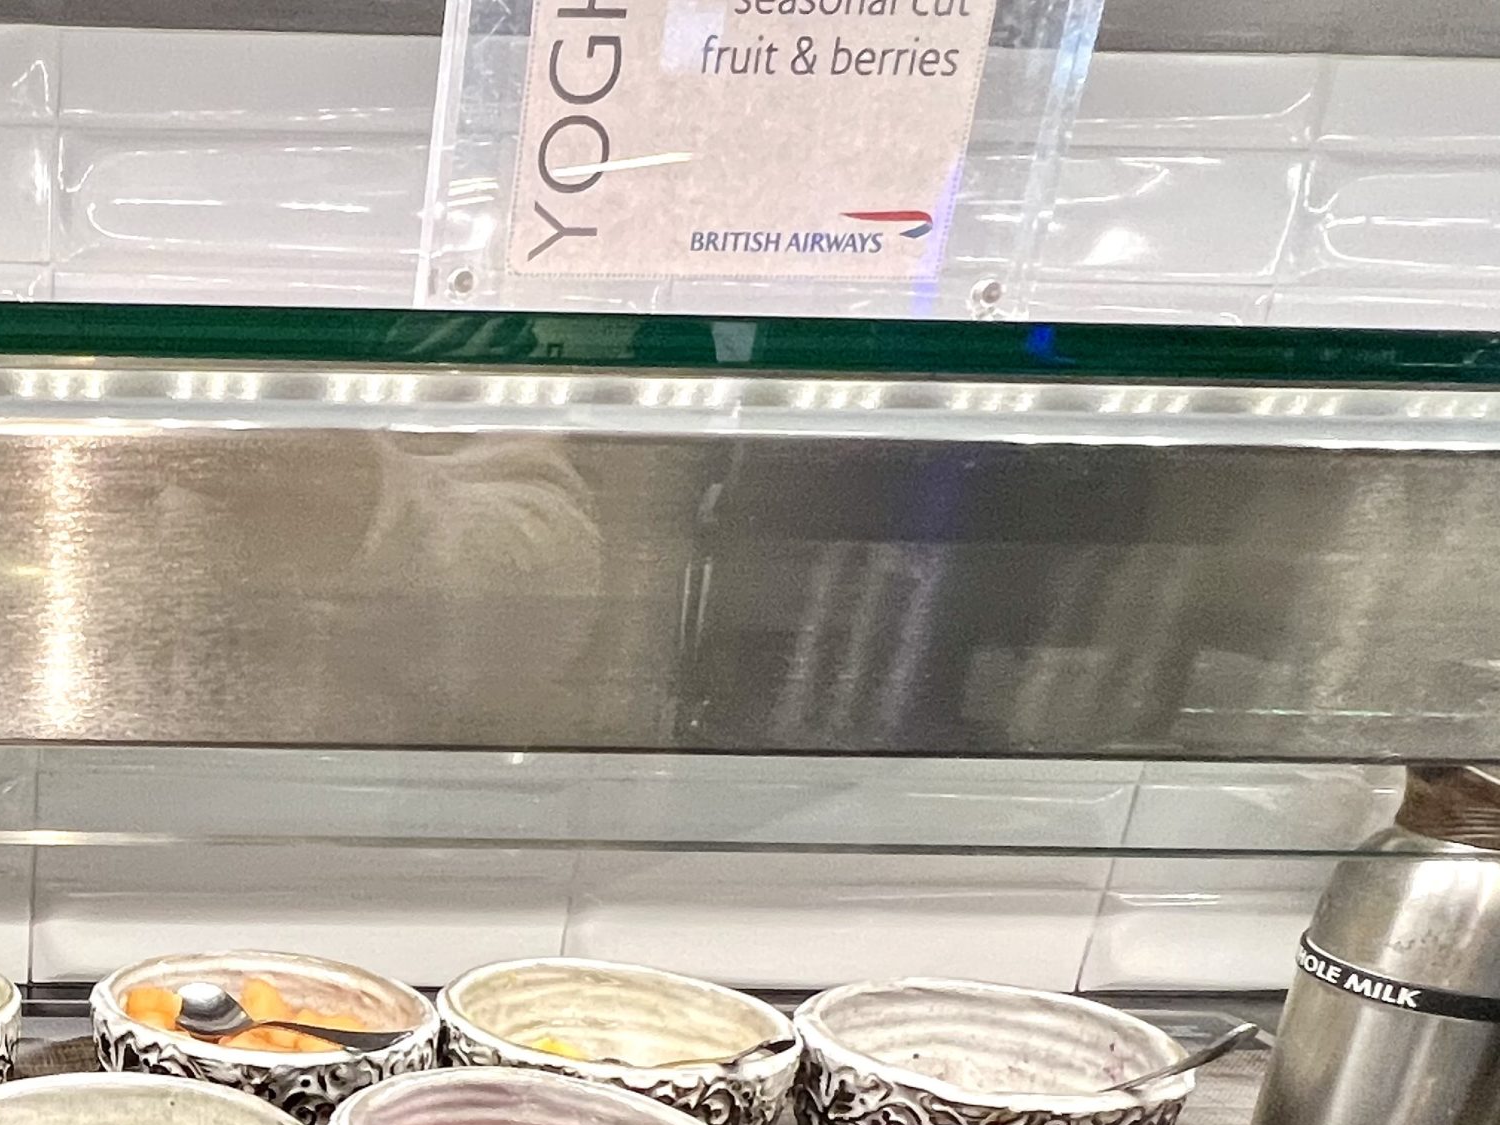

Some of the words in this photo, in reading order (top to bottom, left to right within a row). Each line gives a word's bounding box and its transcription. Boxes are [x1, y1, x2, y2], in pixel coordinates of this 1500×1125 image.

[701, 34, 779, 75] fruit
[790, 35, 818, 76] &
[830, 36, 960, 77] berries
[690, 231, 781, 252] BRITISH
[786, 232, 884, 254] AIRWAYS
[1343, 973, 1422, 1008] MILK
